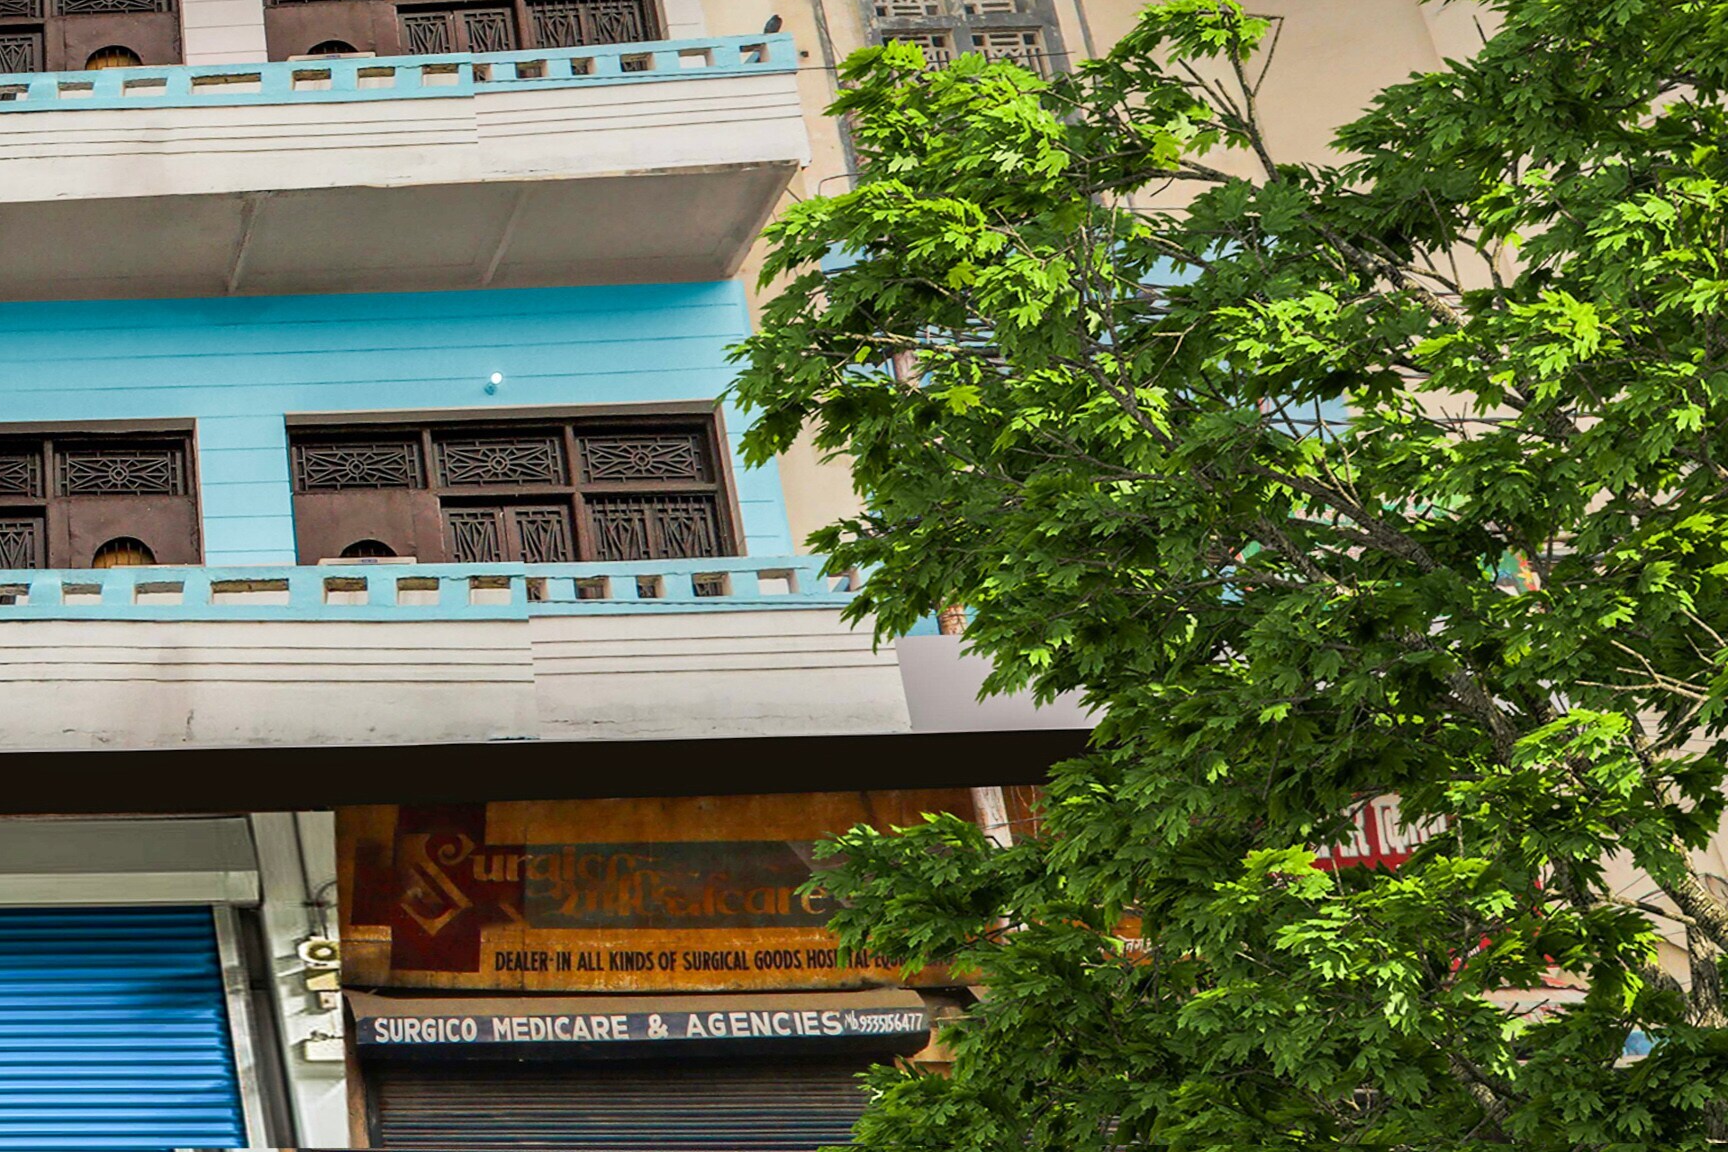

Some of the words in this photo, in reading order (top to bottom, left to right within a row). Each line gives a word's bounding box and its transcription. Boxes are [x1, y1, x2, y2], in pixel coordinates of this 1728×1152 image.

[576, 950, 604, 971] ALL
[609, 950, 655, 971] KINDS
[658, 949, 677, 971] OF
[682, 950, 749, 971] SURGICAL
[806, 948, 870, 969] HOSTAL
[374, 1017, 478, 1043] SURGICO
[492, 1015, 630, 1042] MEDICARE
[647, 1014, 669, 1040] &
[686, 1010, 844, 1038] AGENCIES
